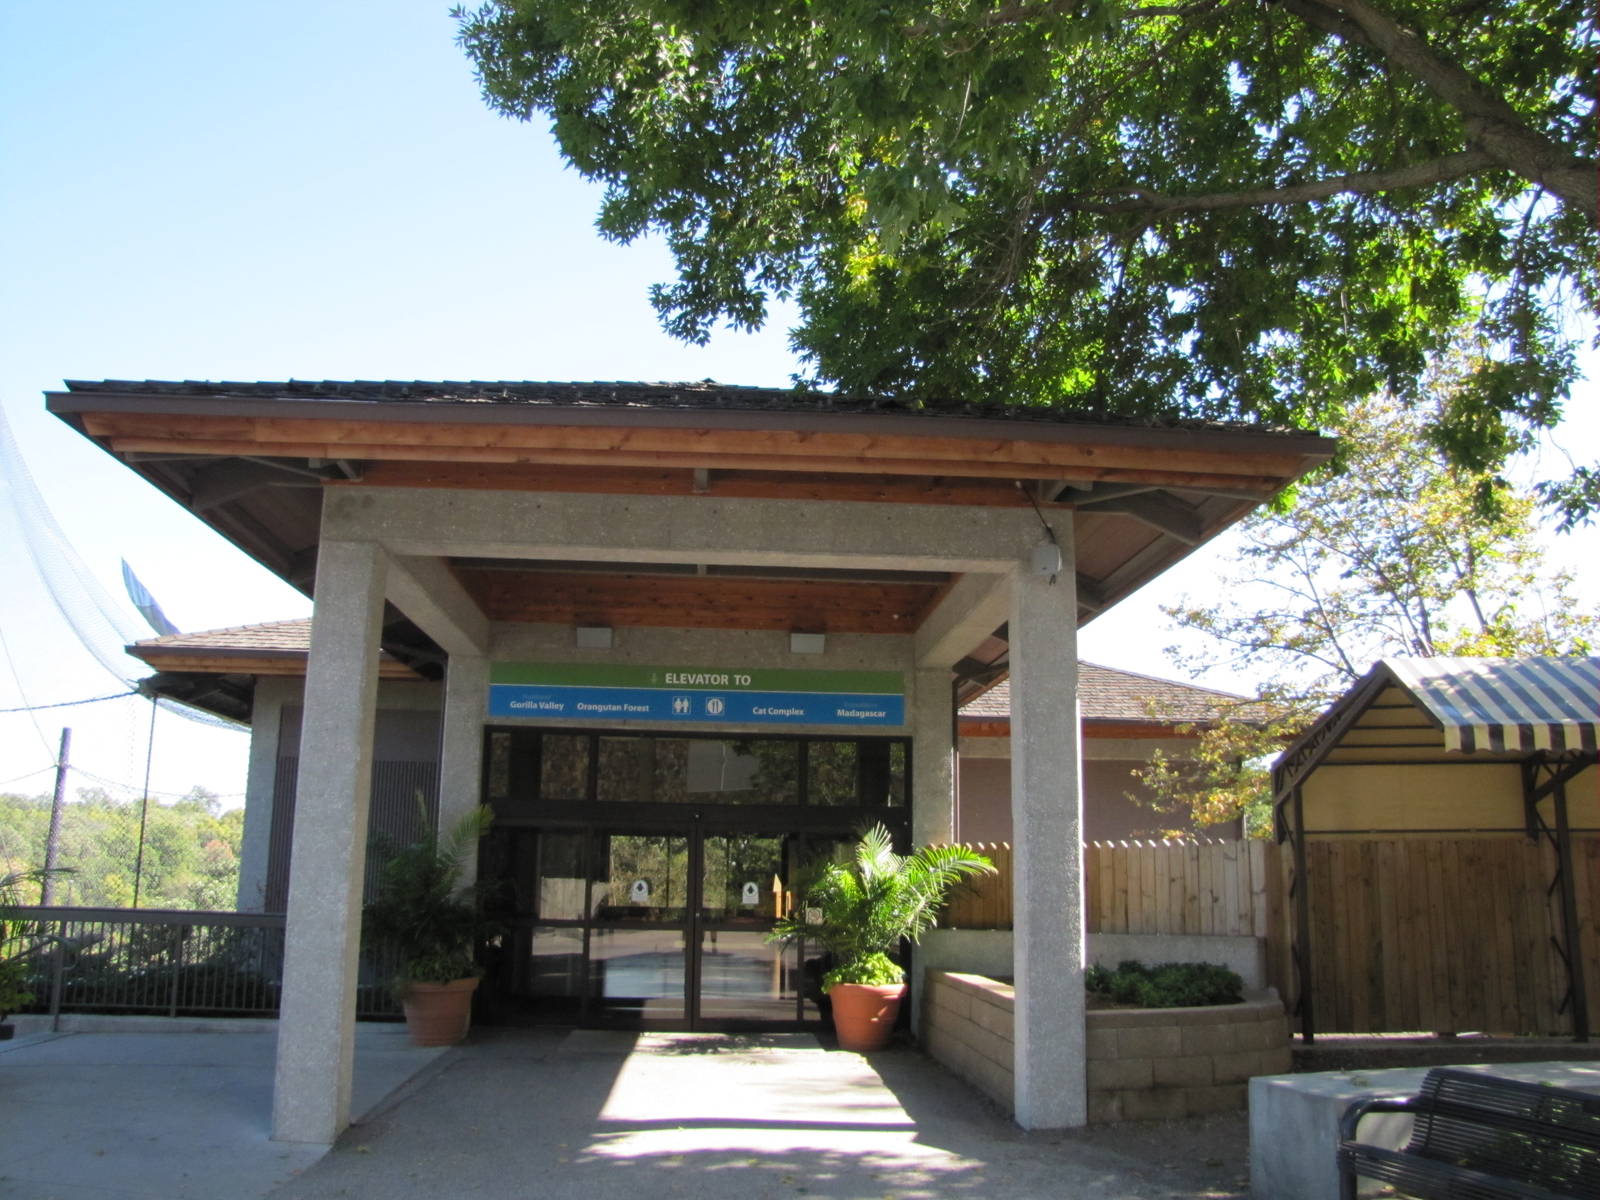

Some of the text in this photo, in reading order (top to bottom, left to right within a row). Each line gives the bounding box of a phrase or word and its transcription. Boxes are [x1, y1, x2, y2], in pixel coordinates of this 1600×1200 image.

[665, 673, 752, 686] ELEVATOR TO
[510, 700, 565, 711] Gorilla Valley
[577, 702, 650, 713] Orangutan Forest
[752, 706, 805, 717] Cat Complex
[837, 709, 887, 719] Madagascar
